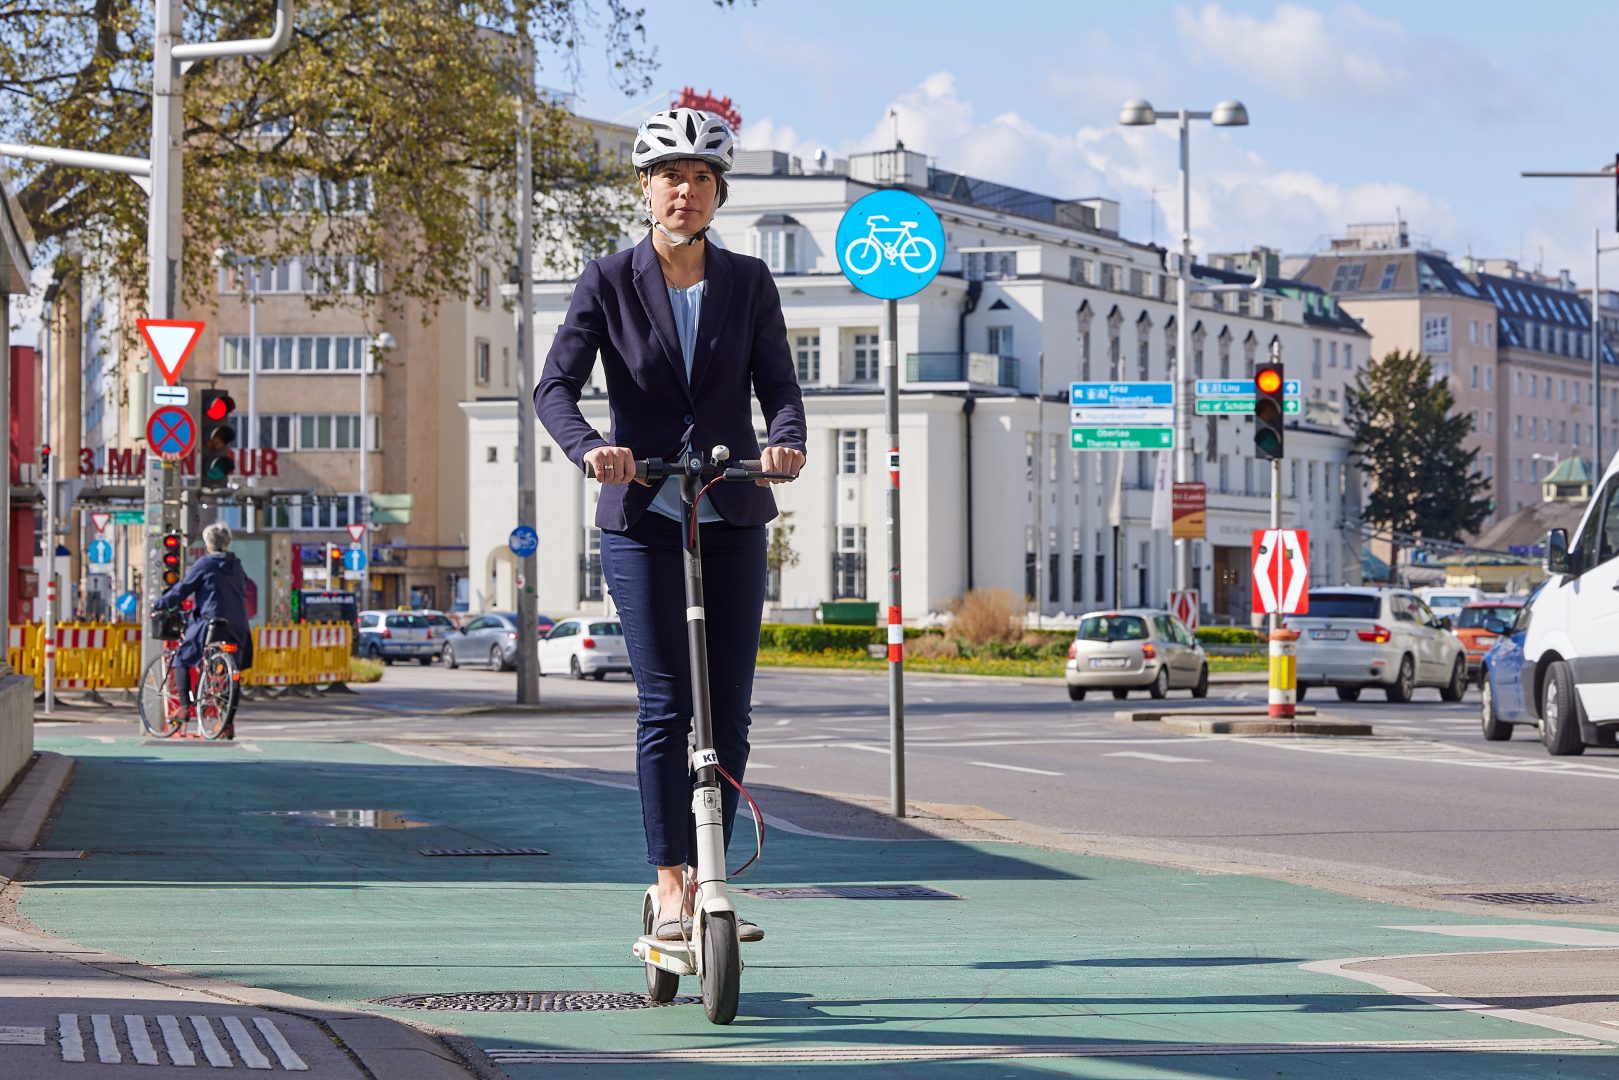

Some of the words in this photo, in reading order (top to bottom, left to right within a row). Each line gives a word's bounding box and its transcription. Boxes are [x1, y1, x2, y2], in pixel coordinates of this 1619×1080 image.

[1109, 384, 1128, 394] Graz
[1222, 383, 1240, 393] Linz
[1224, 401, 1256, 411] Schönb
[1096, 429, 1130, 438] Oberlaa
[1087, 439, 1118, 448] Therme
[1120, 439, 1141, 448] Wien
